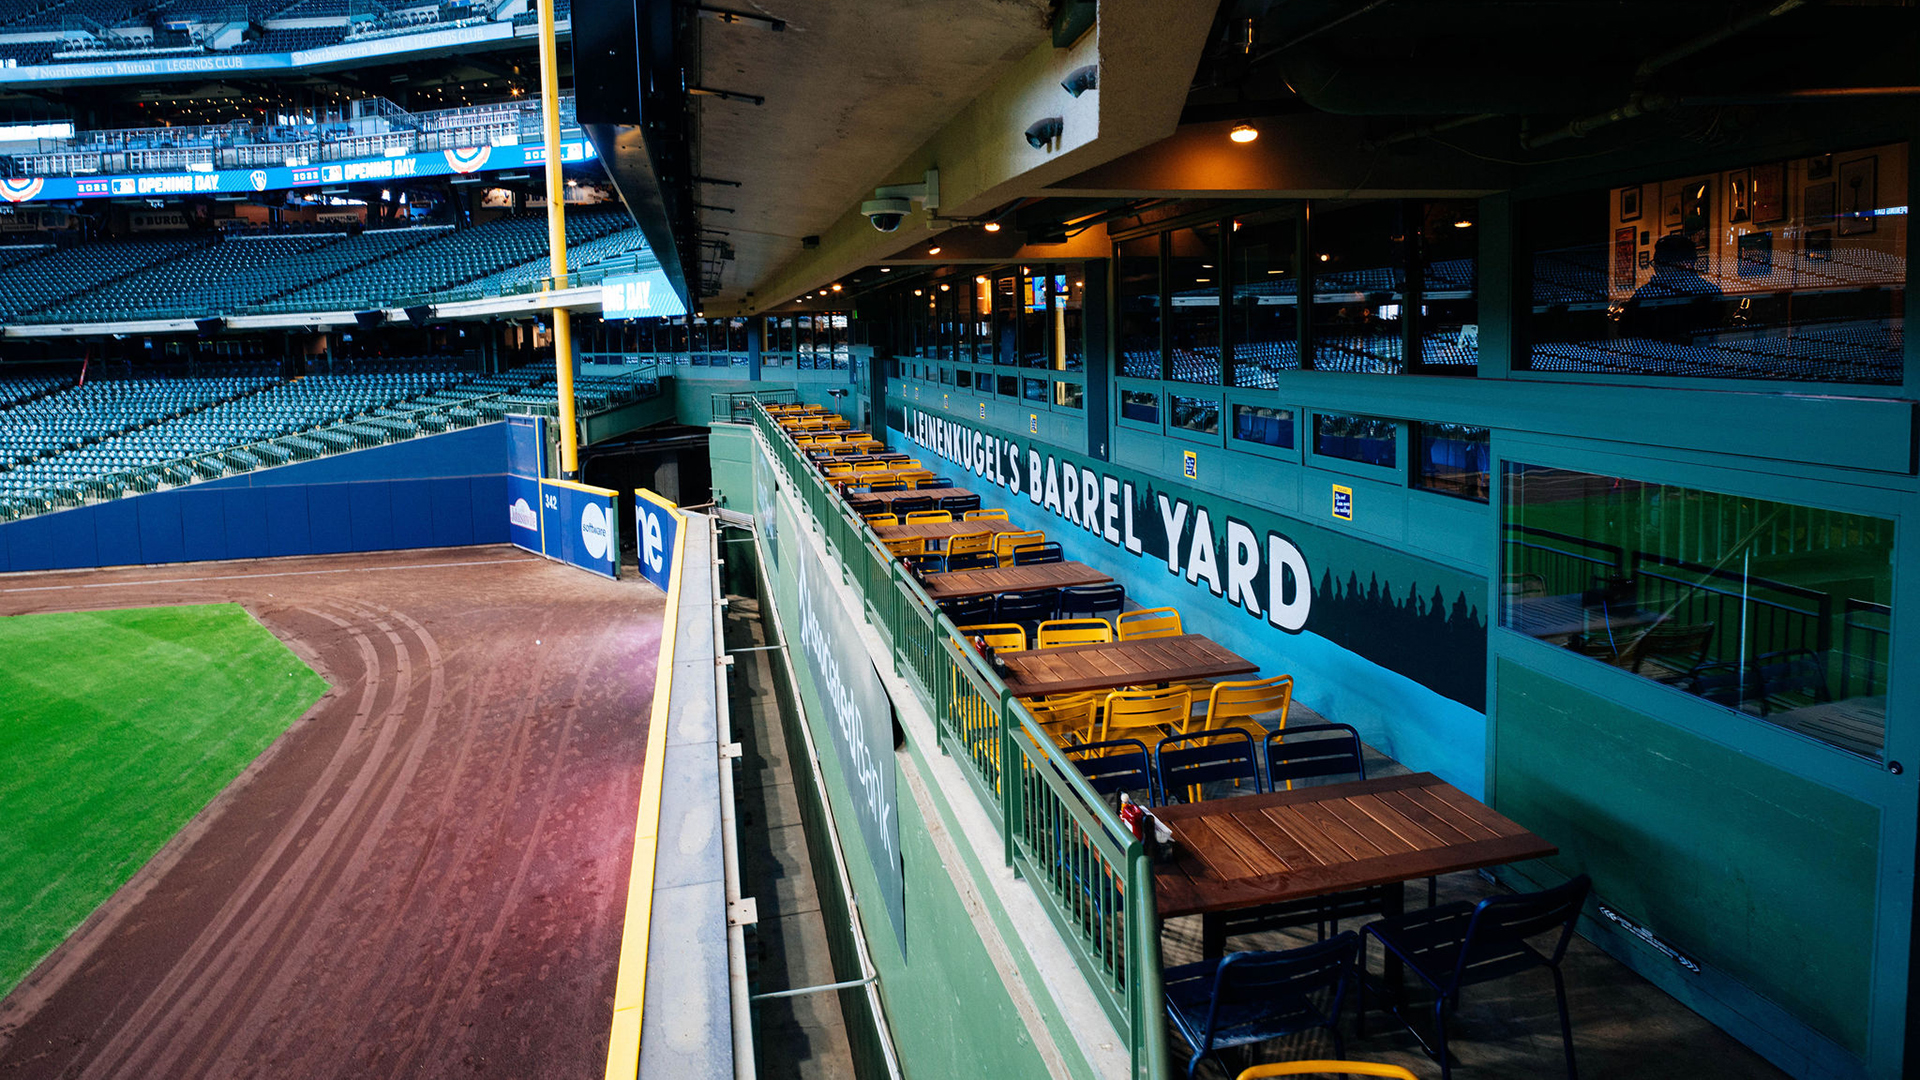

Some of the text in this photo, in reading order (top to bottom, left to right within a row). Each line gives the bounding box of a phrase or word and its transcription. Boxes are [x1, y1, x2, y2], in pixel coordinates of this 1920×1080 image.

[413, 32, 457, 48] LEGENDS
[459, 28, 484, 42] CLUB
[40, 57, 243, 79] Northwestern Mutual LEGENDS CLUB
[345, 161, 392, 180] OPENING
[394, 158, 416, 175] DAY
[138, 176, 192, 193] OPENING
[195, 174, 219, 191] DAY
[626, 280, 651, 310] DAY
[545, 494, 558, 511] 342
[903, 406, 1311, 630] J. LEINENKUGEL'S BARREL YARD
[582, 522, 607, 538] software
